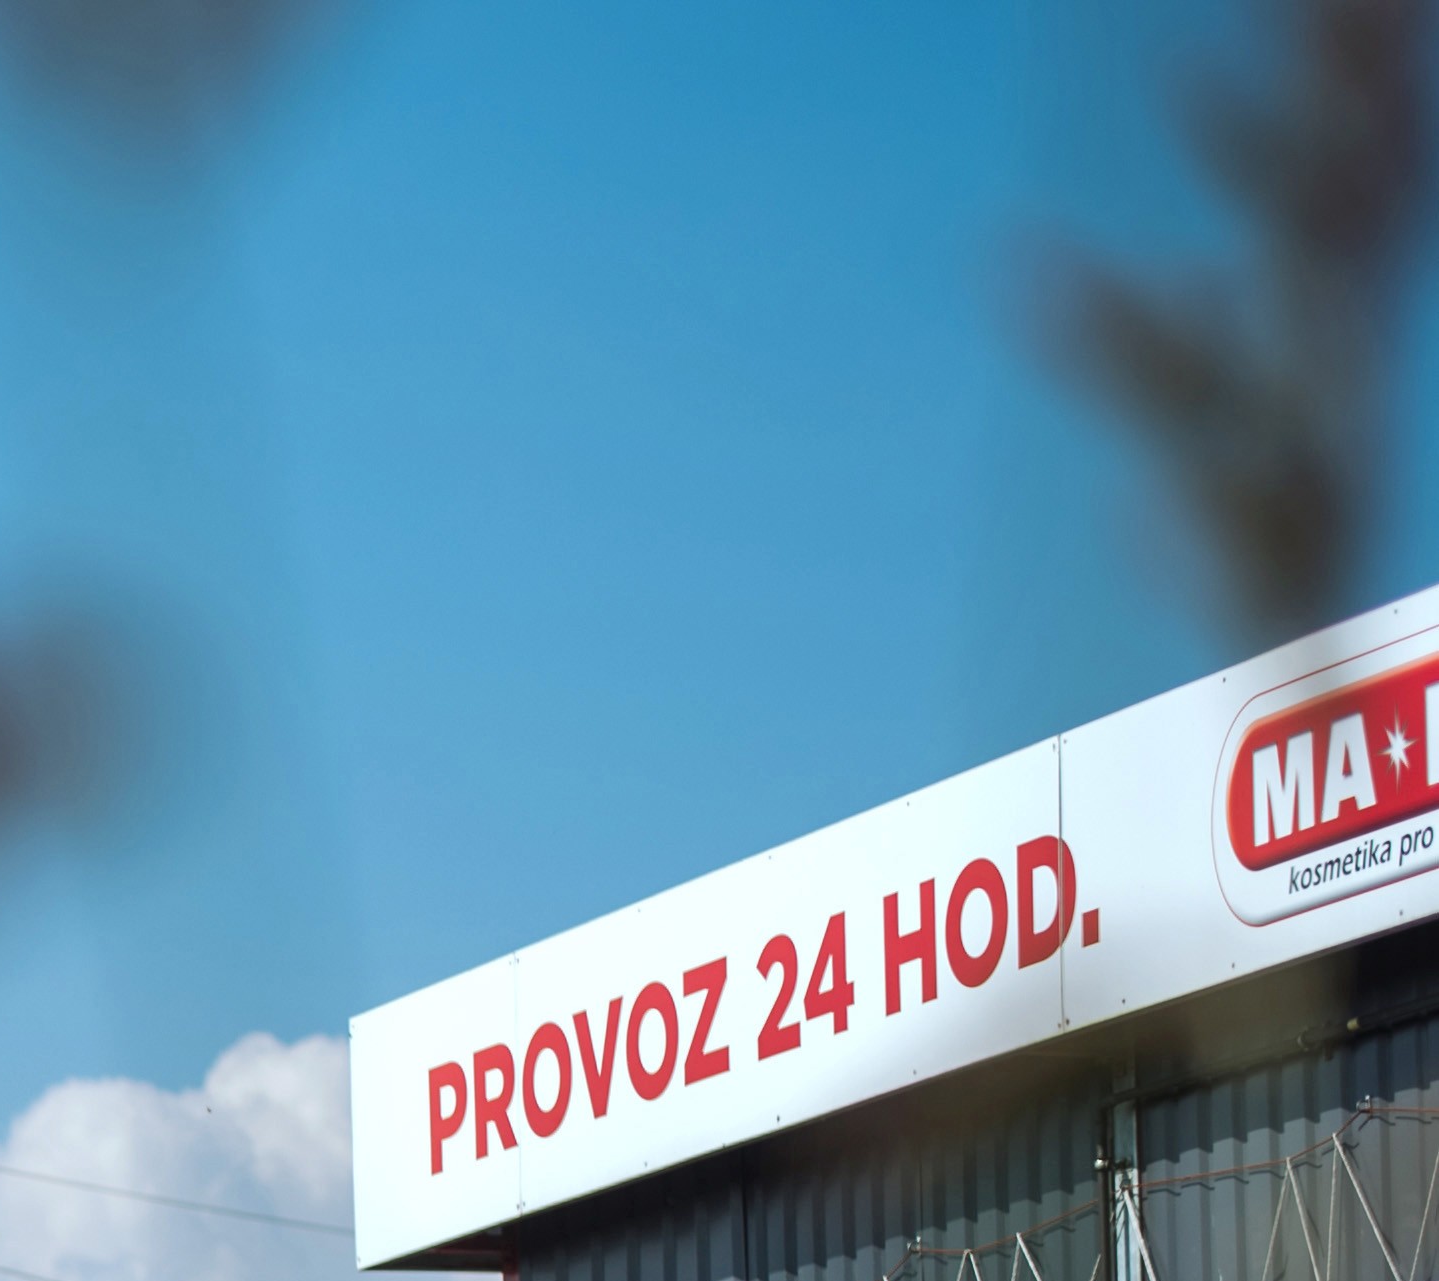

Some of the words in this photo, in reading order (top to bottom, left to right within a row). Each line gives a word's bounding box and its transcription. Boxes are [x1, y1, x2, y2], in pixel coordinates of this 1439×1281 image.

[1287, 839, 1392, 895] kosmetika
[1397, 825, 1434, 867] pro
[427, 956, 730, 1176] PROVOZ
[756, 910, 856, 1062] 24
[882, 833, 1102, 1016] HOD.
